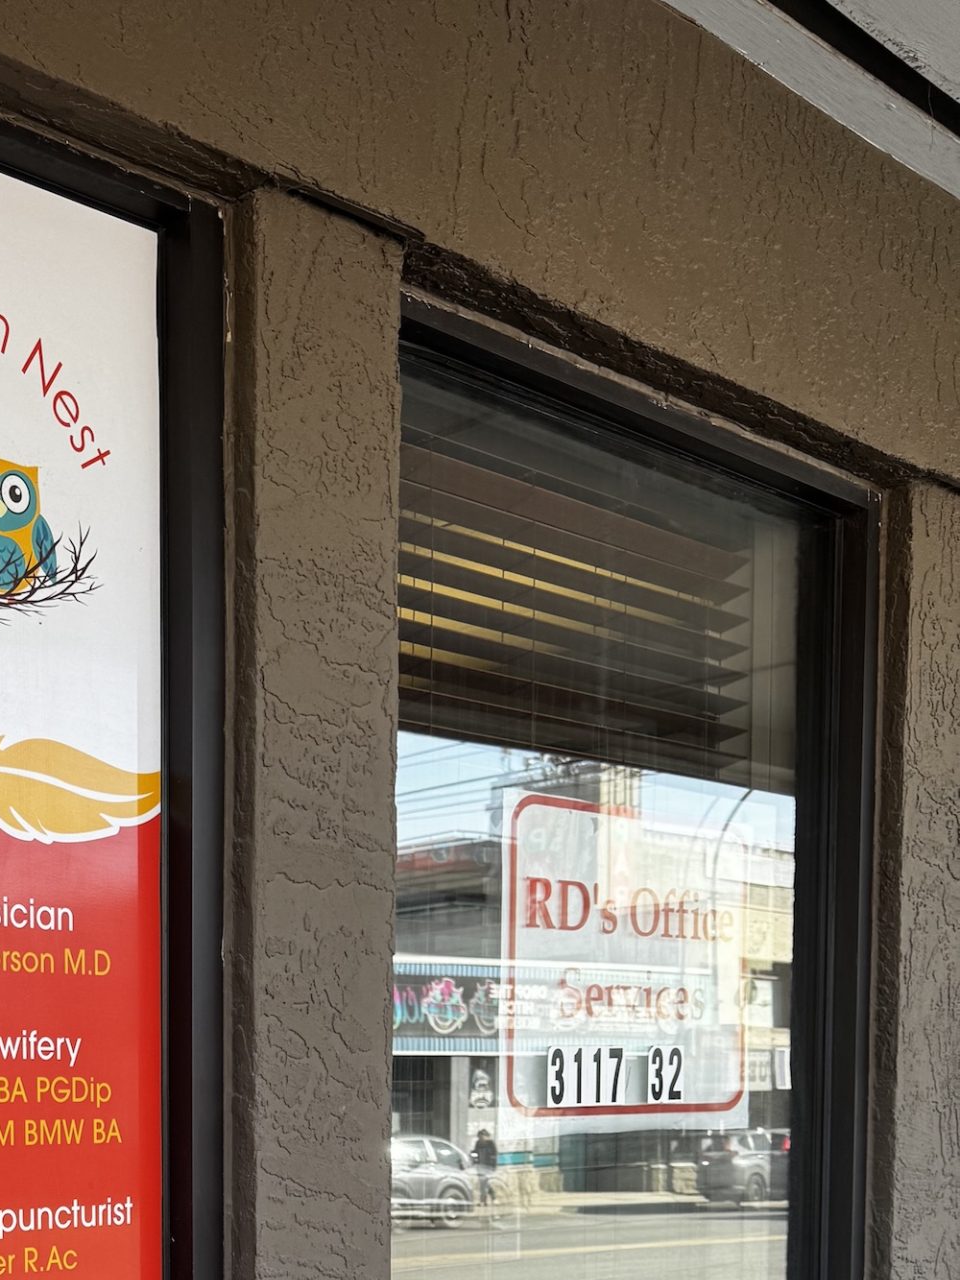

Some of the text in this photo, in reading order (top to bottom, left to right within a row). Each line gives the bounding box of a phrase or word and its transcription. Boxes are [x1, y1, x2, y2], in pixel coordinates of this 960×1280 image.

[22, 338, 111, 469] Nest
[526, 877, 733, 942] RD's Office
[64, 948, 111, 976] M.D
[557, 968, 705, 1021] Services
[36, 1076, 111, 1108] PGDip
[551, 1048, 682, 1104] 3117 32
[24, 1119, 84, 1146] BMW
[93, 1118, 122, 1144] BA
[24, 1246, 78, 1273] R.Ac
